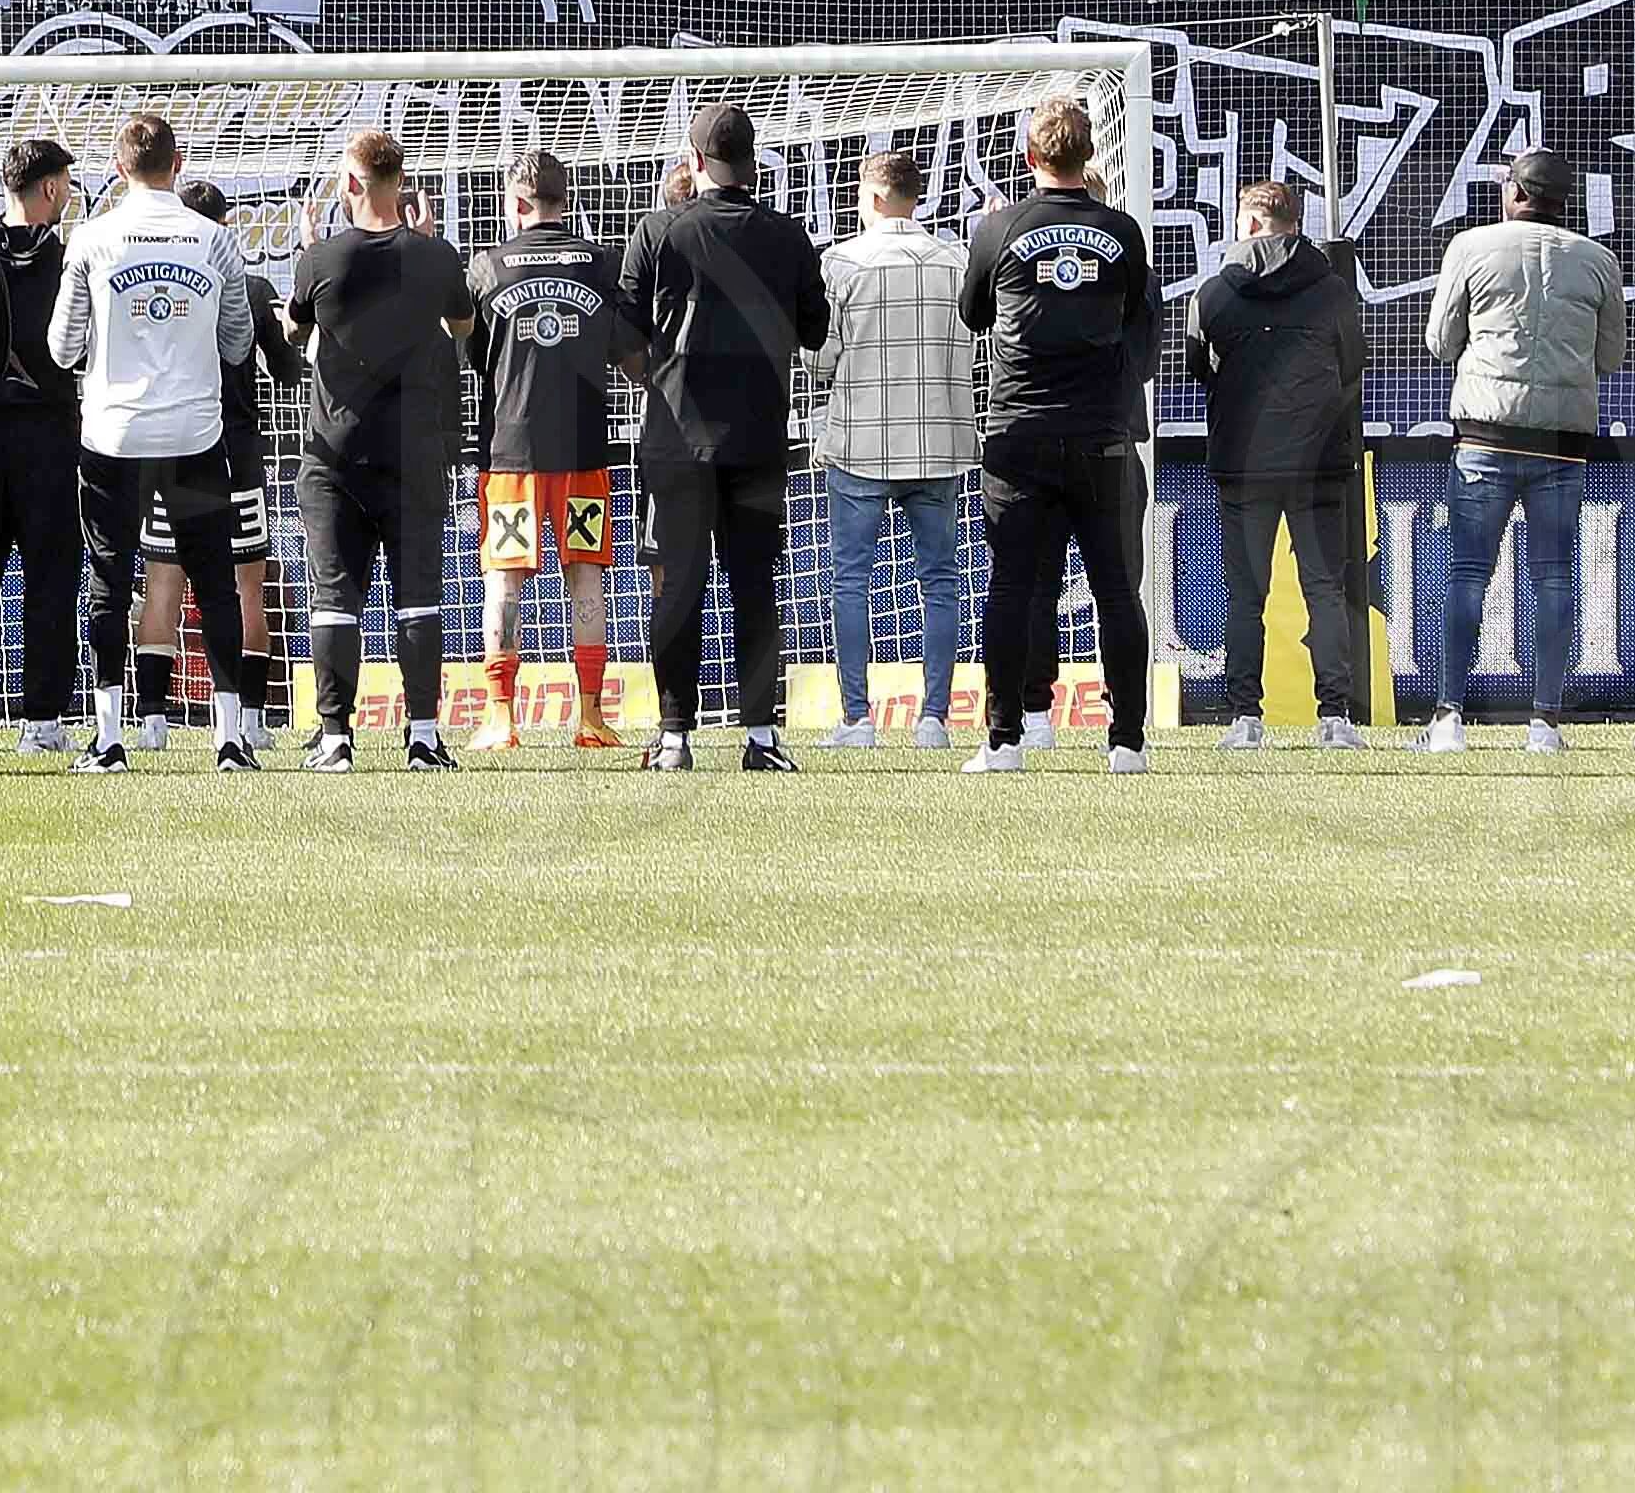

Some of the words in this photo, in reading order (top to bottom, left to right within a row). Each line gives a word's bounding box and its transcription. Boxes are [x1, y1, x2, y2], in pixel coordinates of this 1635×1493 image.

[1015, 225, 1120, 261] PUNTIGAMER
[111, 262, 213, 296] PUNTIGAMER
[493, 277, 601, 317] PUNTIGAMER
